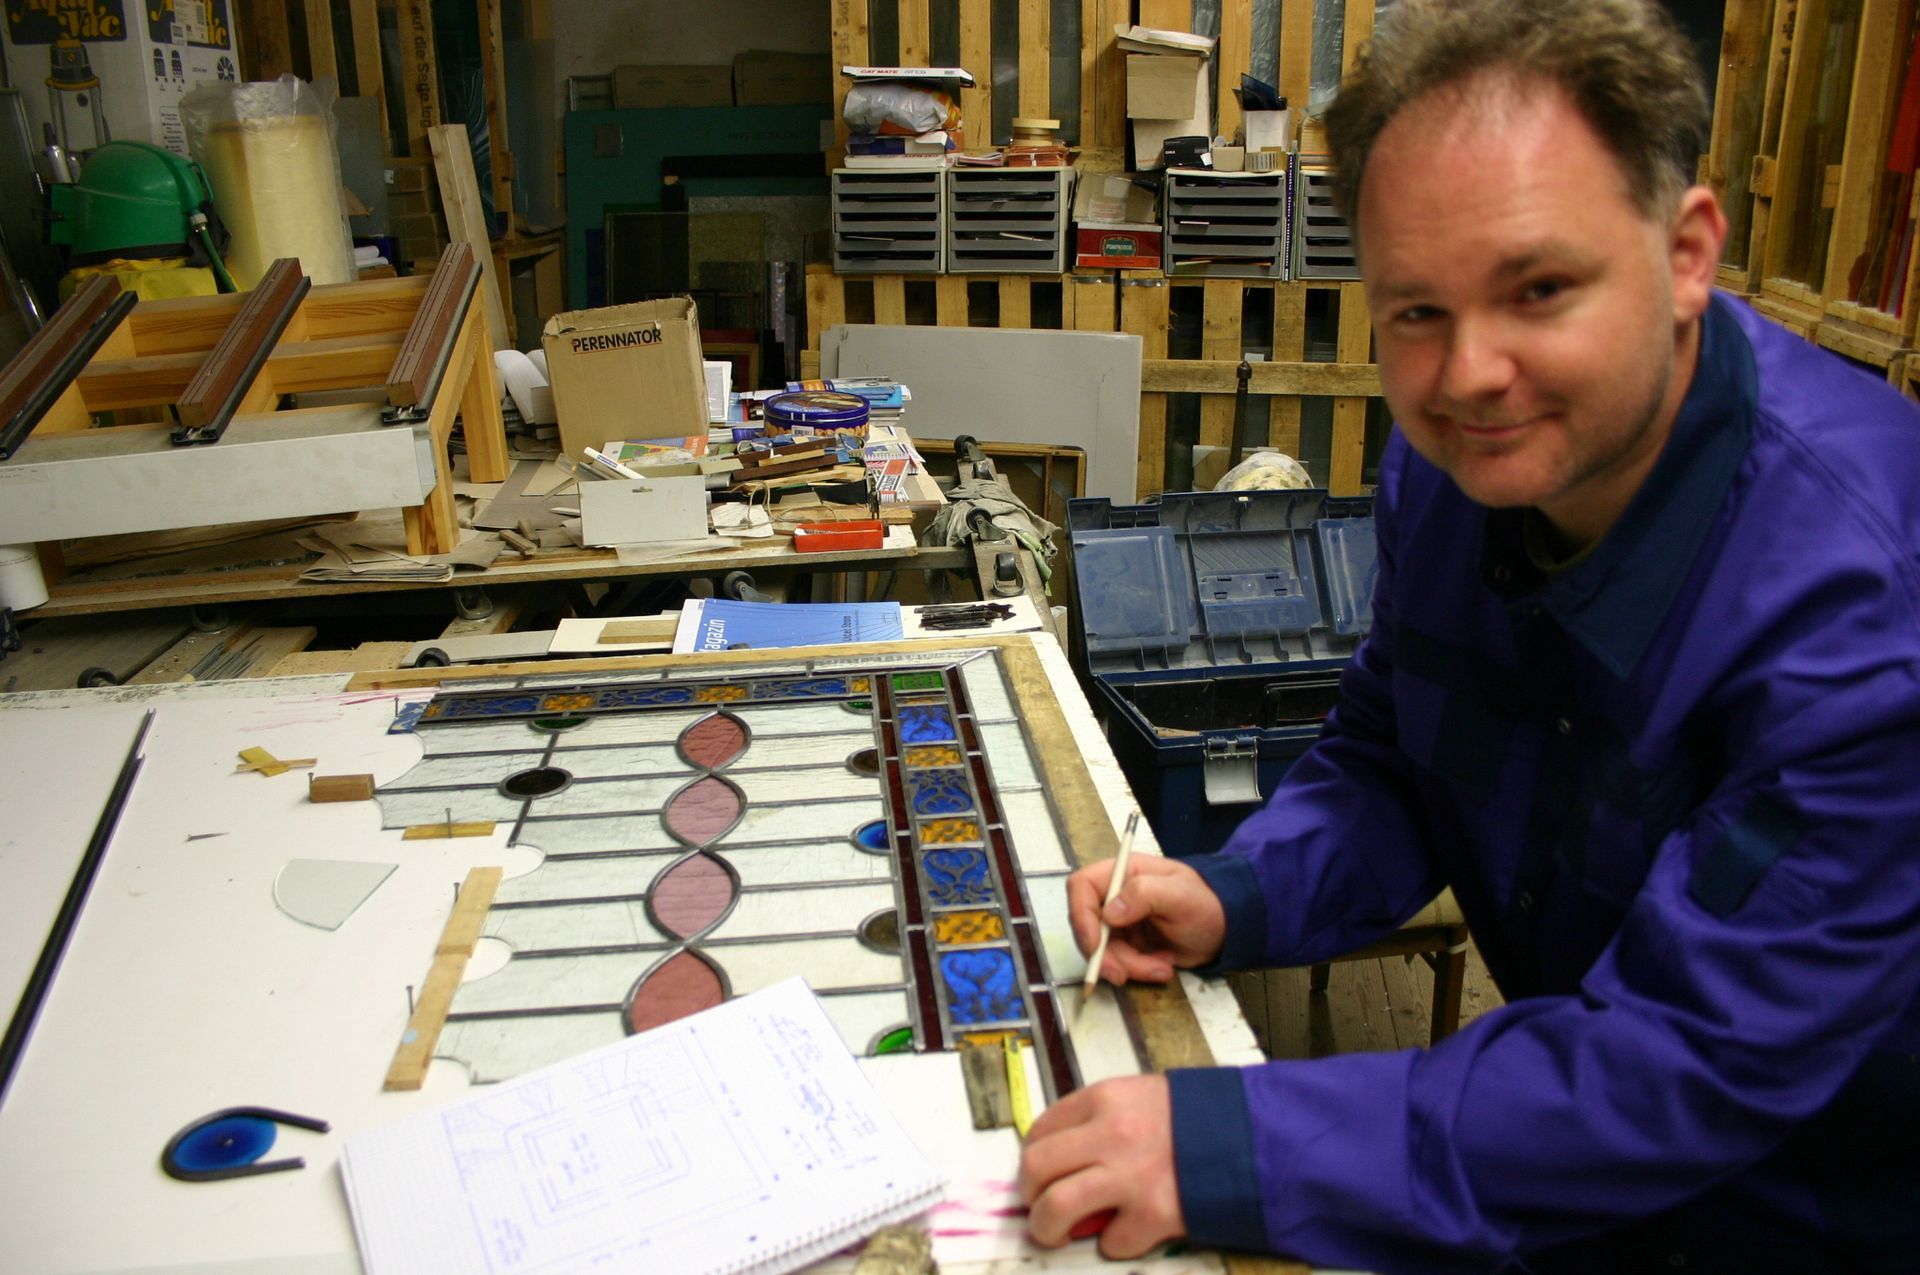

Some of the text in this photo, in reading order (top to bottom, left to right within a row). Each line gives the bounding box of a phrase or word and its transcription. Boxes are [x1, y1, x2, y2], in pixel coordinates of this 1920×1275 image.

[58, 10, 121, 37] Vac
[572, 328, 662, 352] PERENNATOR
[700, 619, 727, 651] agazin
